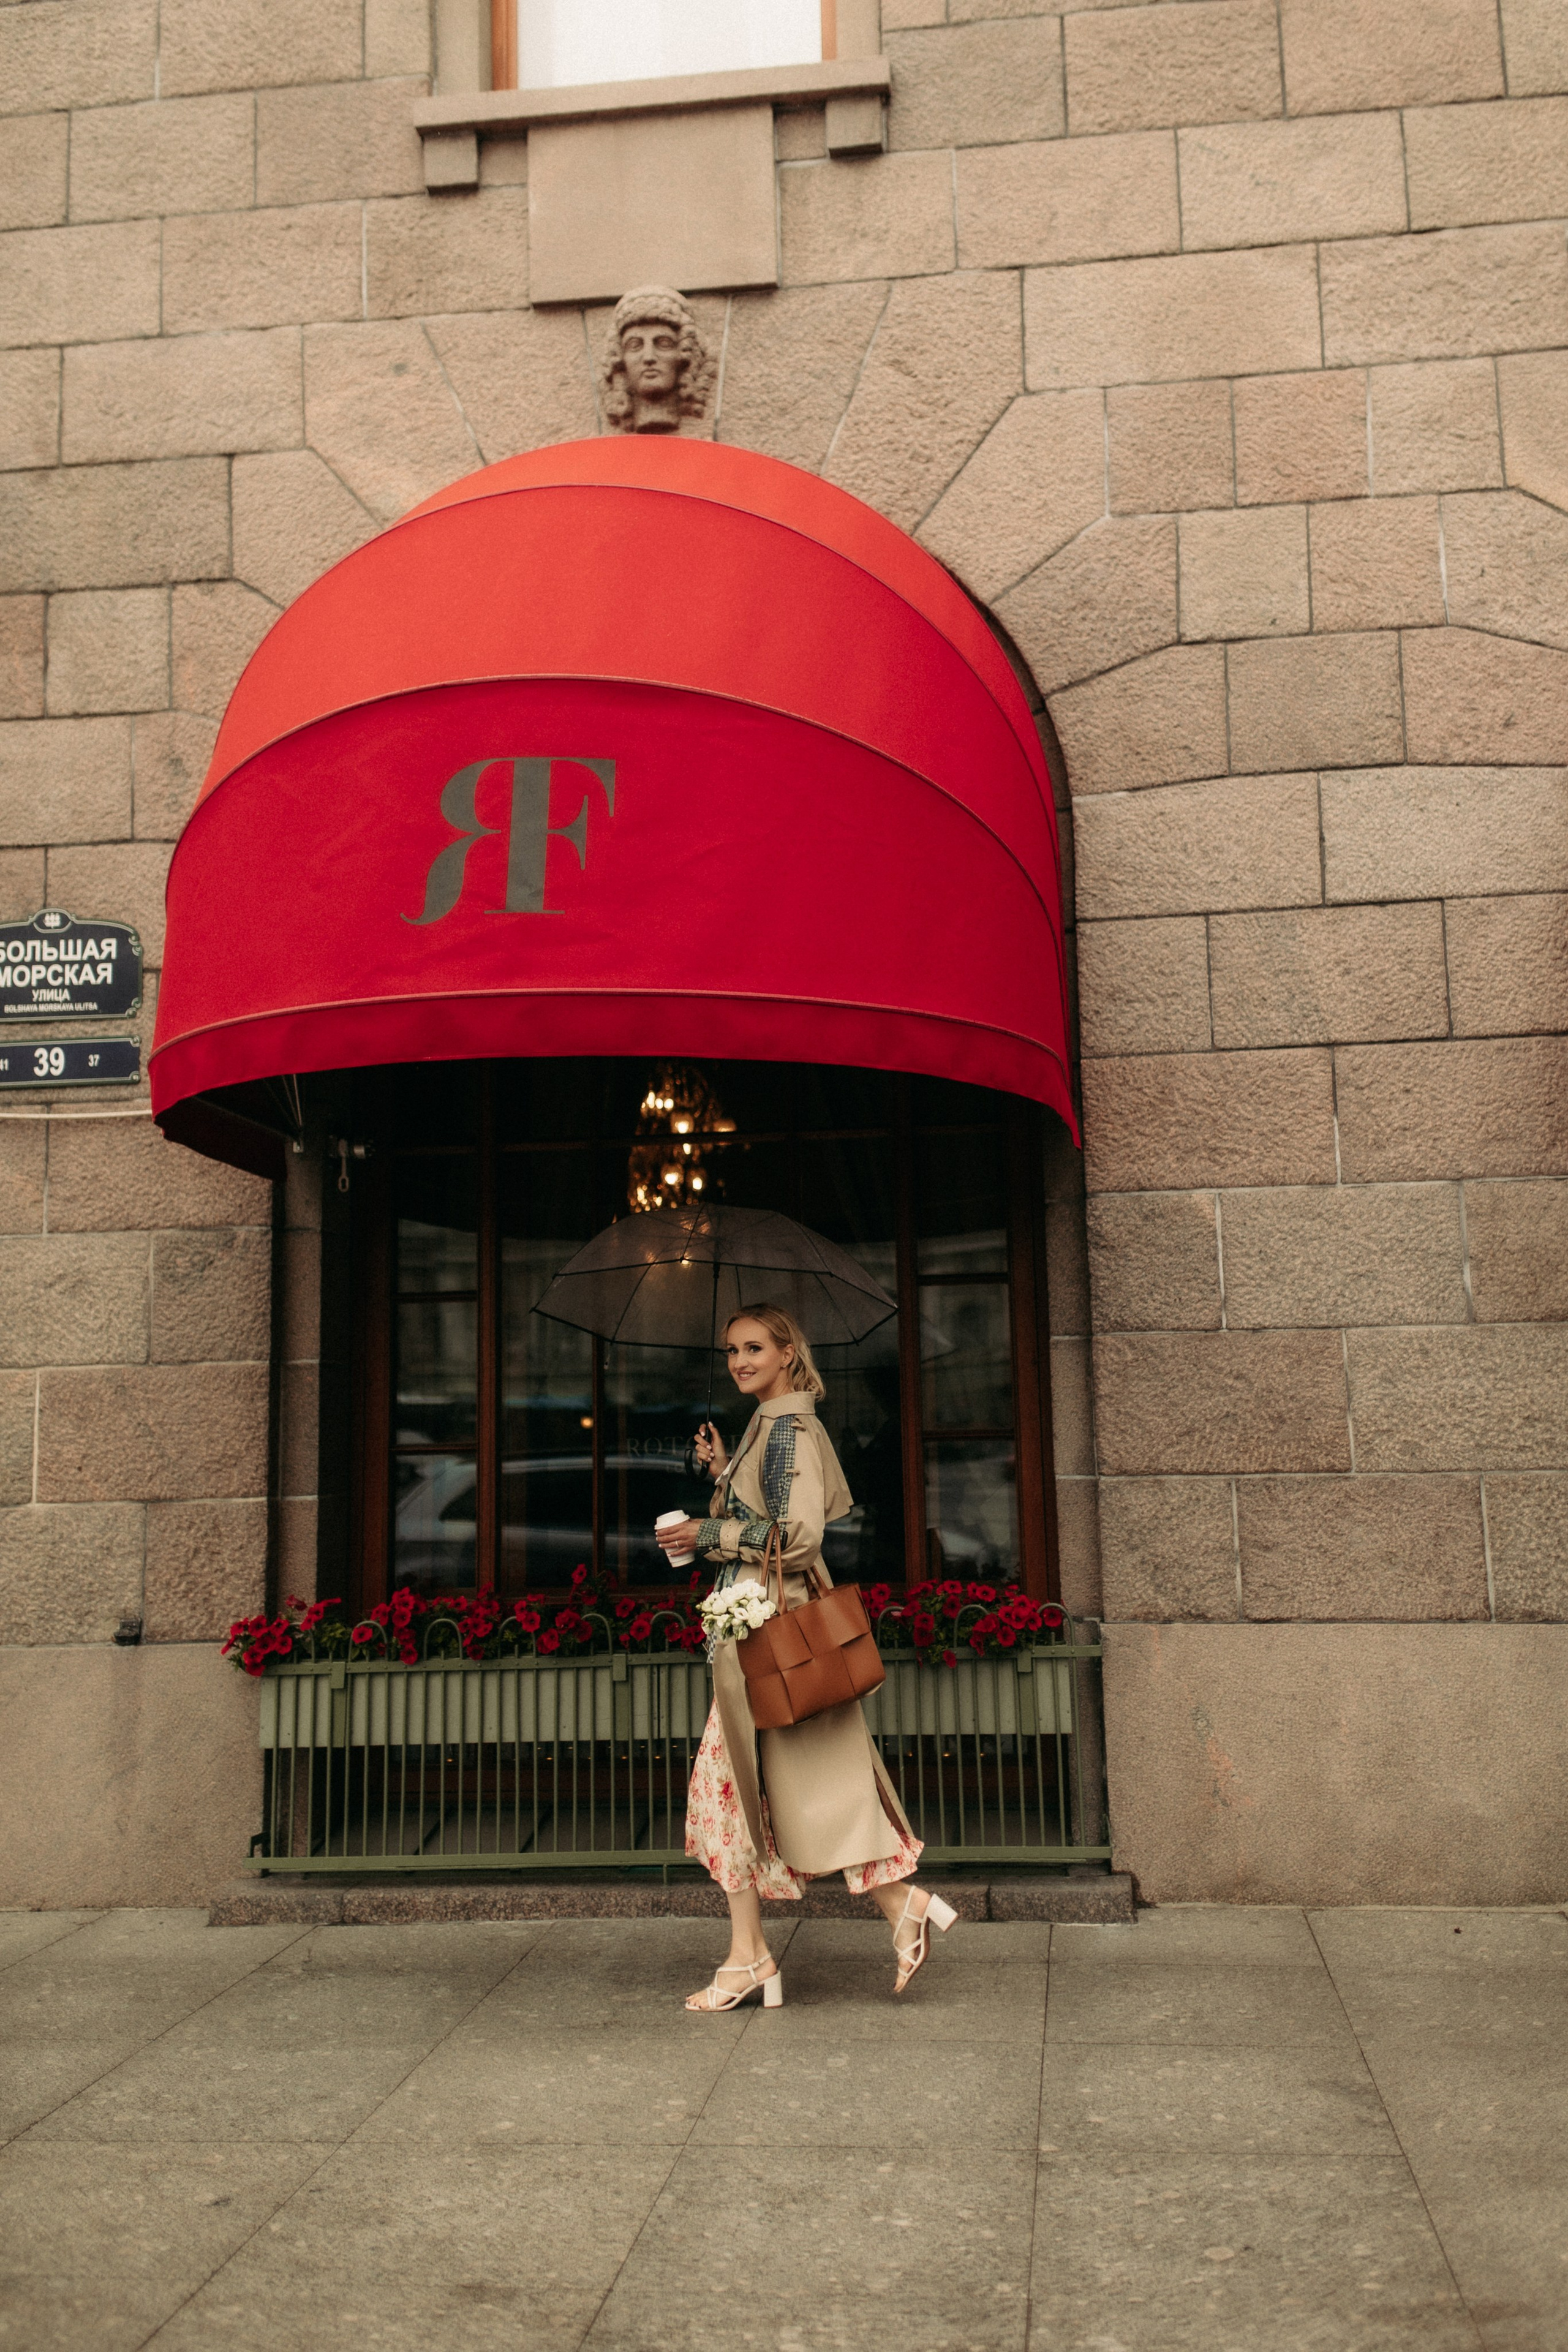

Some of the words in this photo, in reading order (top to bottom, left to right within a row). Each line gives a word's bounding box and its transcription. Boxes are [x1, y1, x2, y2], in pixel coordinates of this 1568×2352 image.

[32, 989, 70, 1002] УЛИЦА
[4, 1004, 37, 1013] BOLSHAYA
[39, 1003, 74, 1012] MORSKAYA
[75, 1001, 97, 1011] ULITSA
[33, 1047, 65, 1077] 39
[88, 1054, 100, 1067] 37
